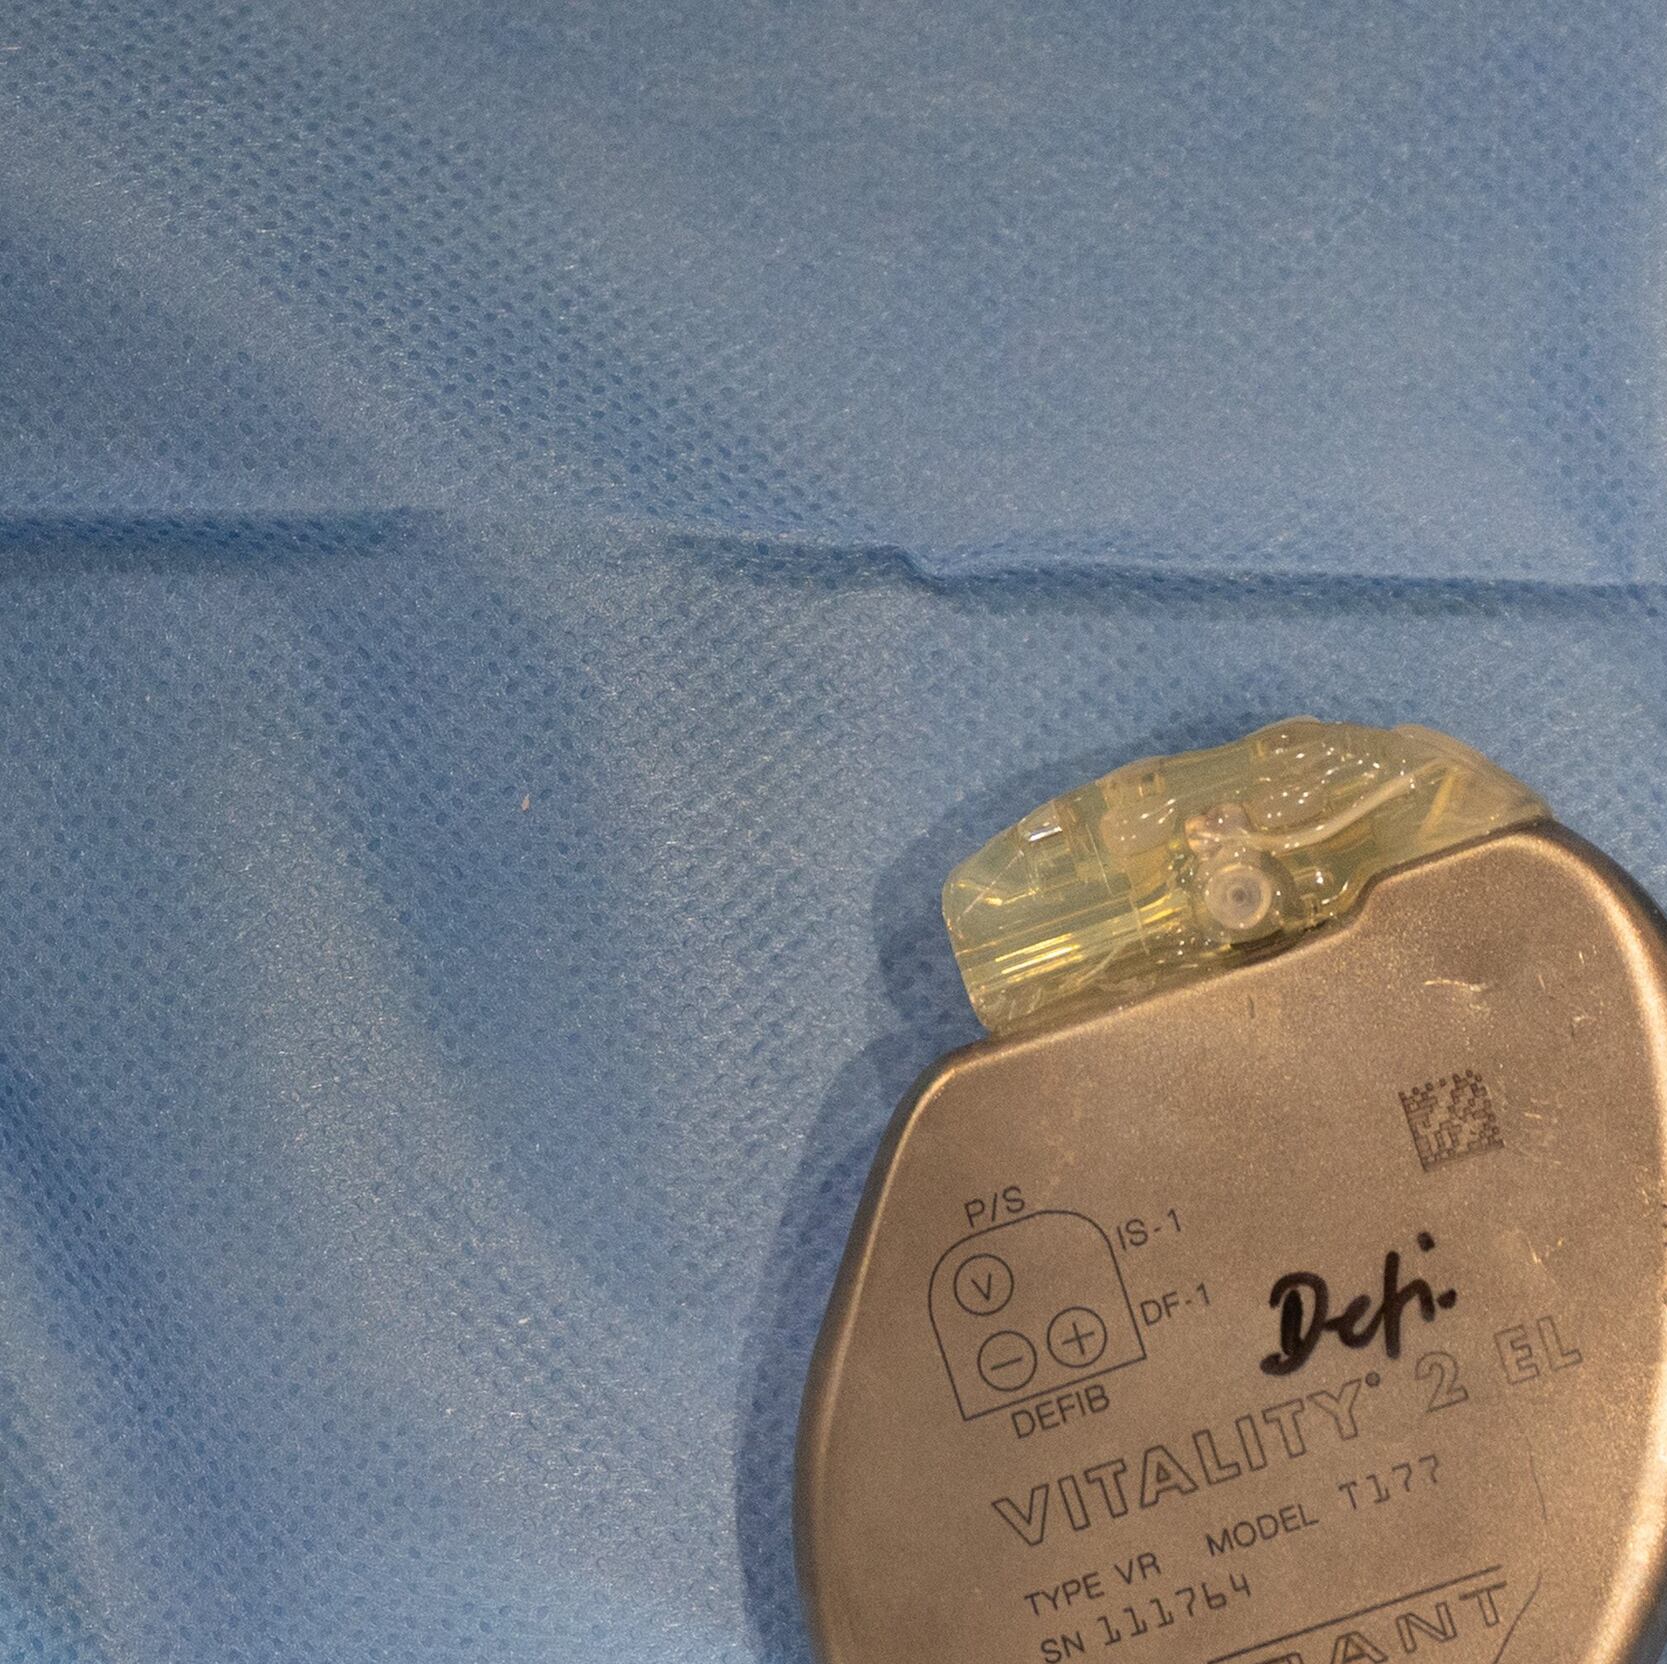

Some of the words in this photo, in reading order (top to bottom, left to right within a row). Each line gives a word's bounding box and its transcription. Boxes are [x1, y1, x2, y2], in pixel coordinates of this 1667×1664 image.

[964, 1185, 1025, 1227] P/S
[1116, 1208, 1182, 1251] IS-1
[971, 1273, 992, 1300] V
[1140, 1282, 1211, 1326] DF-1
[1414, 1350, 1469, 1414] 2
[1493, 1315, 1582, 1385] EL
[1011, 1384, 1110, 1439] DEFIB
[1024, 1571, 1105, 1616] TYPE
[1114, 1552, 1161, 1585] VR
[1205, 1504, 1319, 1557] MODEL
[1338, 1454, 1439, 1510] T177
[1040, 1631, 1085, 1664] SN
[1097, 1573, 1251, 1646] 111764
